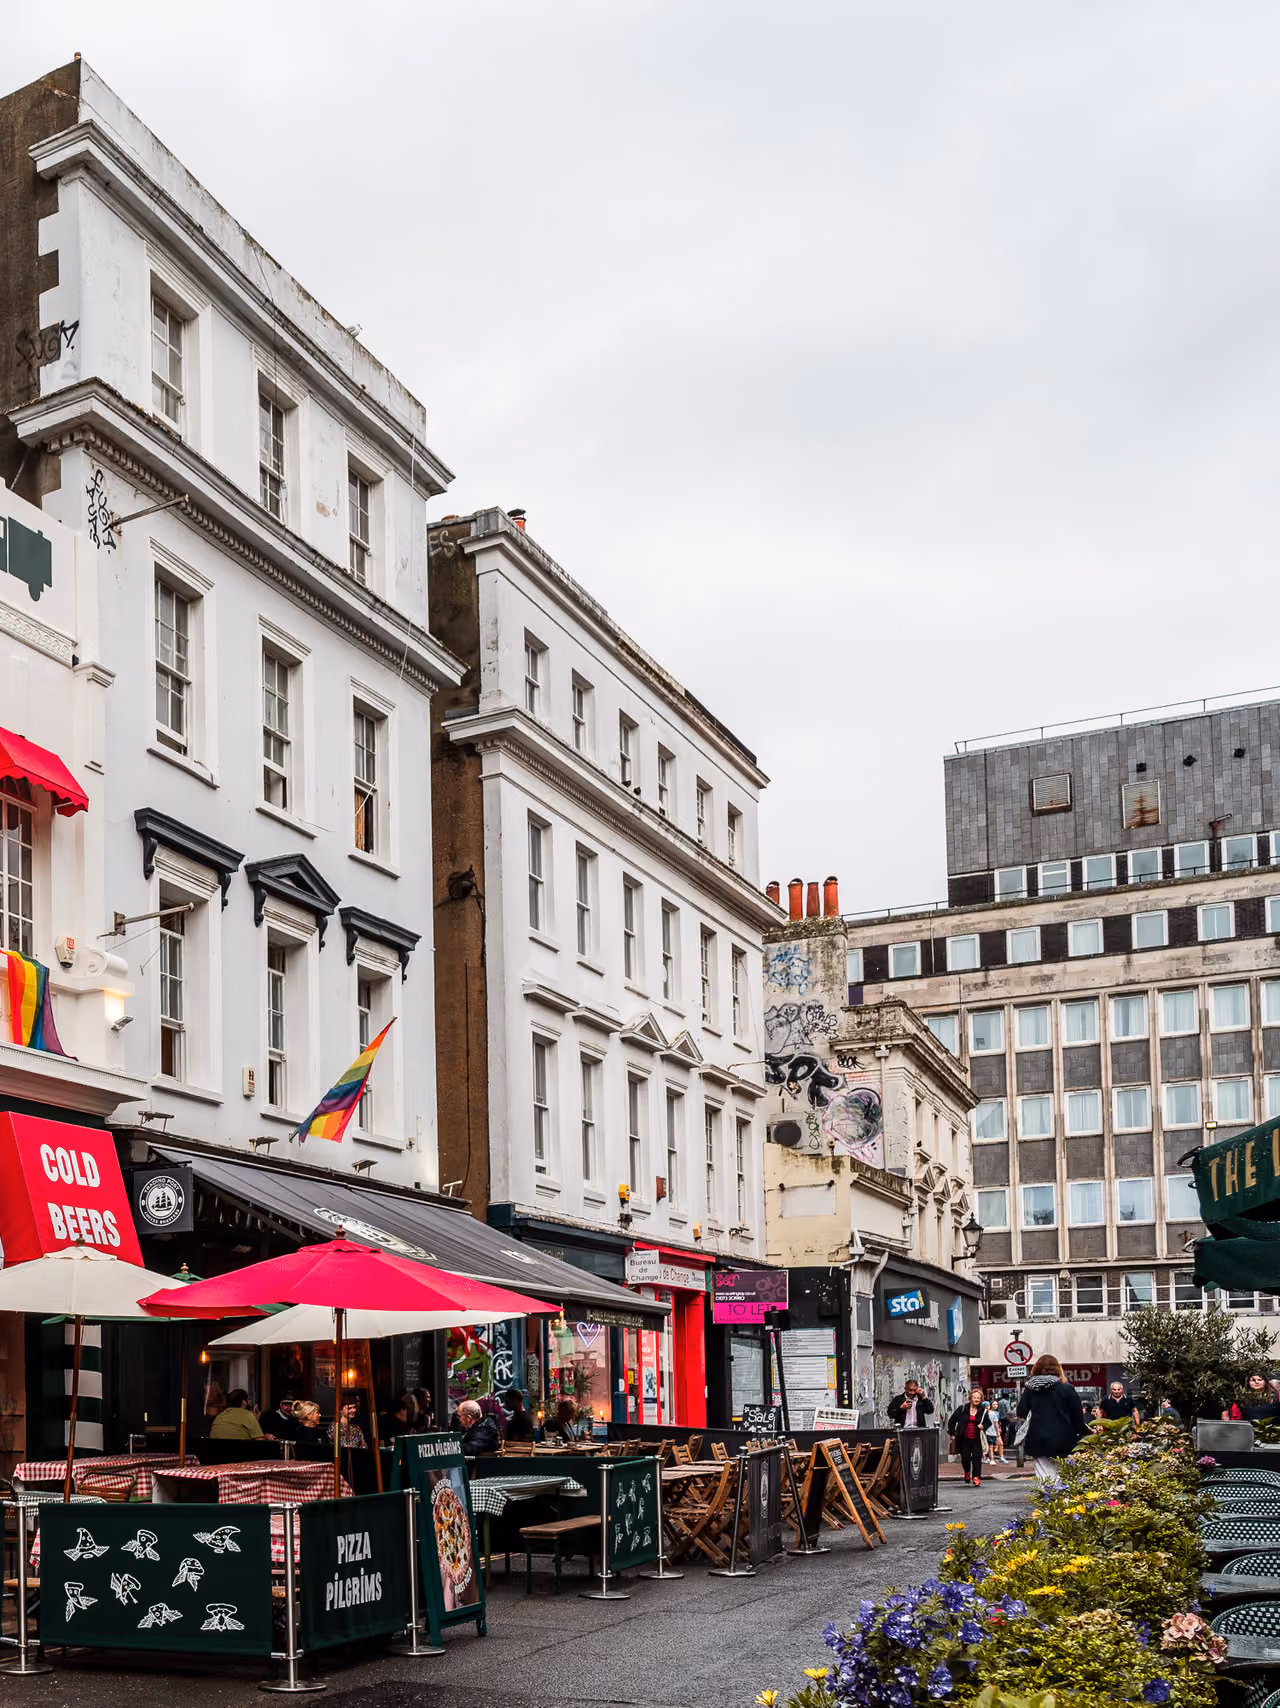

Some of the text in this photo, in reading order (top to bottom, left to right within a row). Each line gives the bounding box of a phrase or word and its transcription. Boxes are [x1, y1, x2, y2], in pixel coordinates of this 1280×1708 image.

[39, 1143, 101, 1188] COLD
[1208, 1136, 1257, 1202] THE
[166, 1179, 180, 1190] POST
[47, 1202, 121, 1248] BEERS
[630, 1259, 657, 1267] Bureau
[630, 1274, 659, 1282] Change
[728, 1303, 747, 1316] TO
[890, 1295, 920, 1313] sta
[418, 1443, 435, 1459] PIZZA
[336, 1531, 372, 1564] PIZZA
